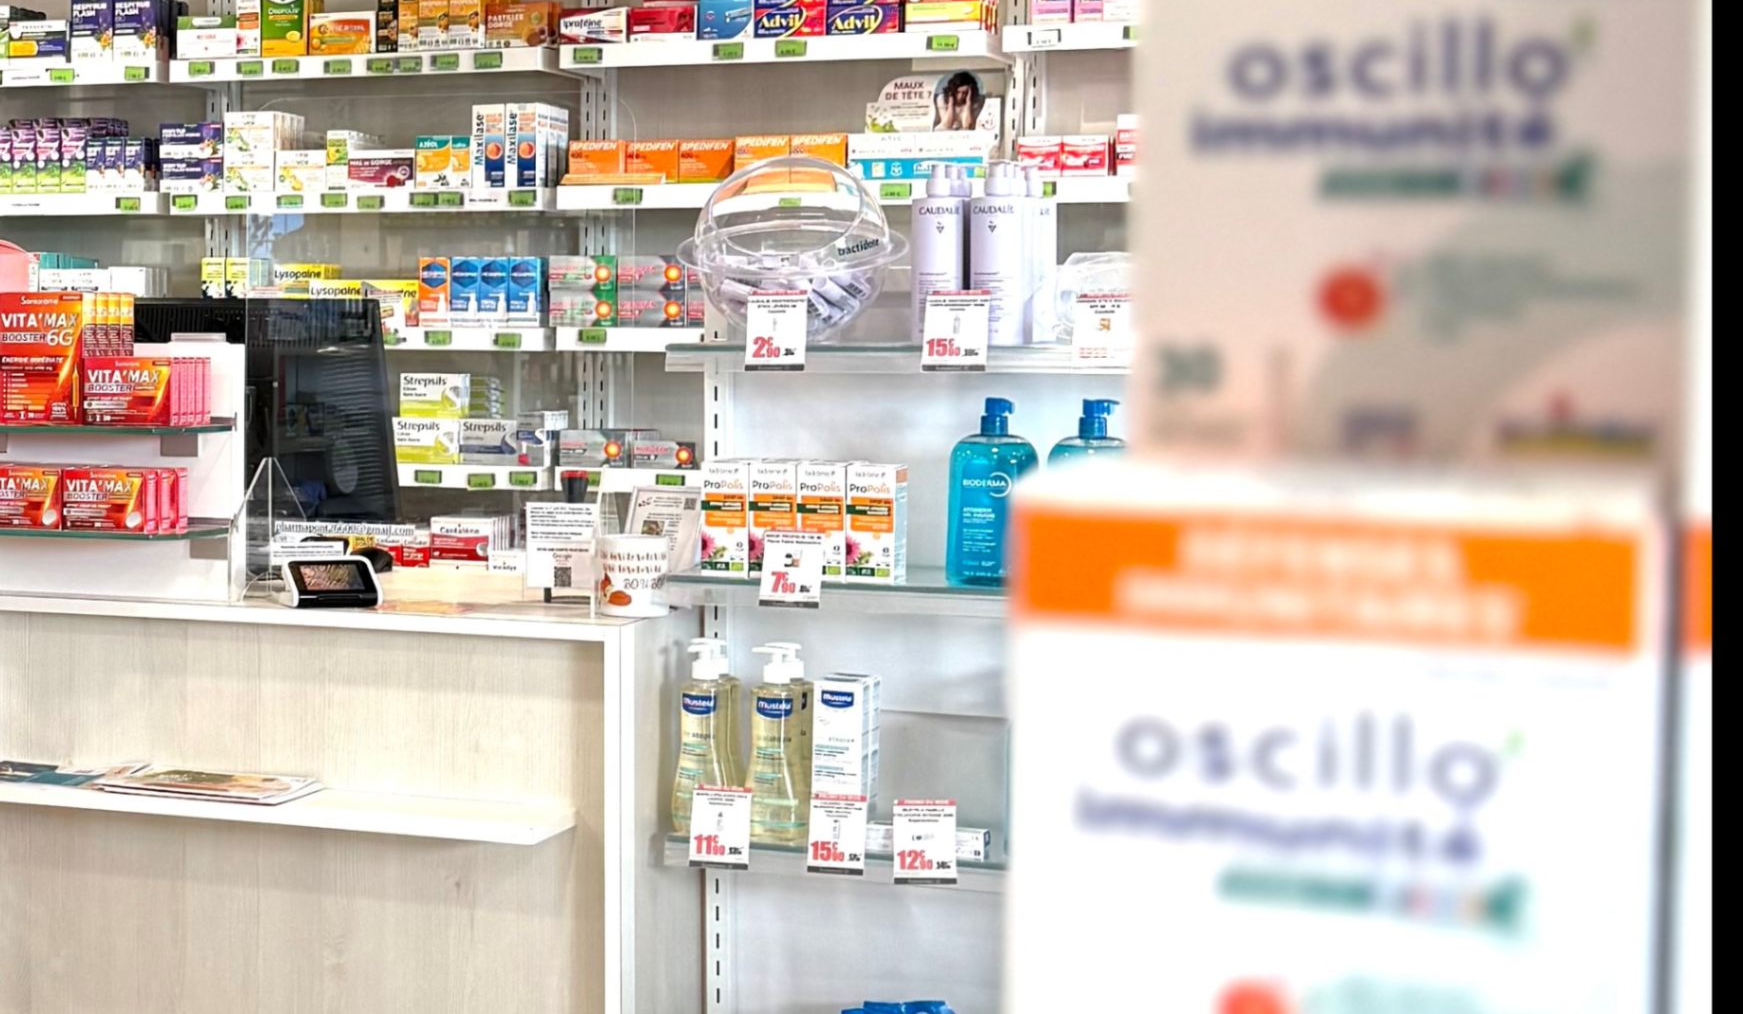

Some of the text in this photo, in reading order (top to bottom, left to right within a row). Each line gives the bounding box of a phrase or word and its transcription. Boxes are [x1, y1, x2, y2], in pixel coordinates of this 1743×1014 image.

[758, 11, 801, 29] Advil
[832, 14, 876, 32] Advil
[1224, 14, 1572, 101] oscillo
[893, 82, 924, 90] MAUX
[885, 93, 898, 101] DE
[900, 90, 926, 101] TÊTE
[474, 114, 485, 166] Maxilase
[506, 112, 518, 165] Maxilase
[1, 329, 74, 346] BOOSTER 6G
[87, 383, 132, 393] BOOSTER
[403, 376, 447, 387] Strepsils
[397, 421, 440, 433] Strepsils
[463, 421, 506, 433] Strepsils
[1114, 710, 1499, 803] oscillo
